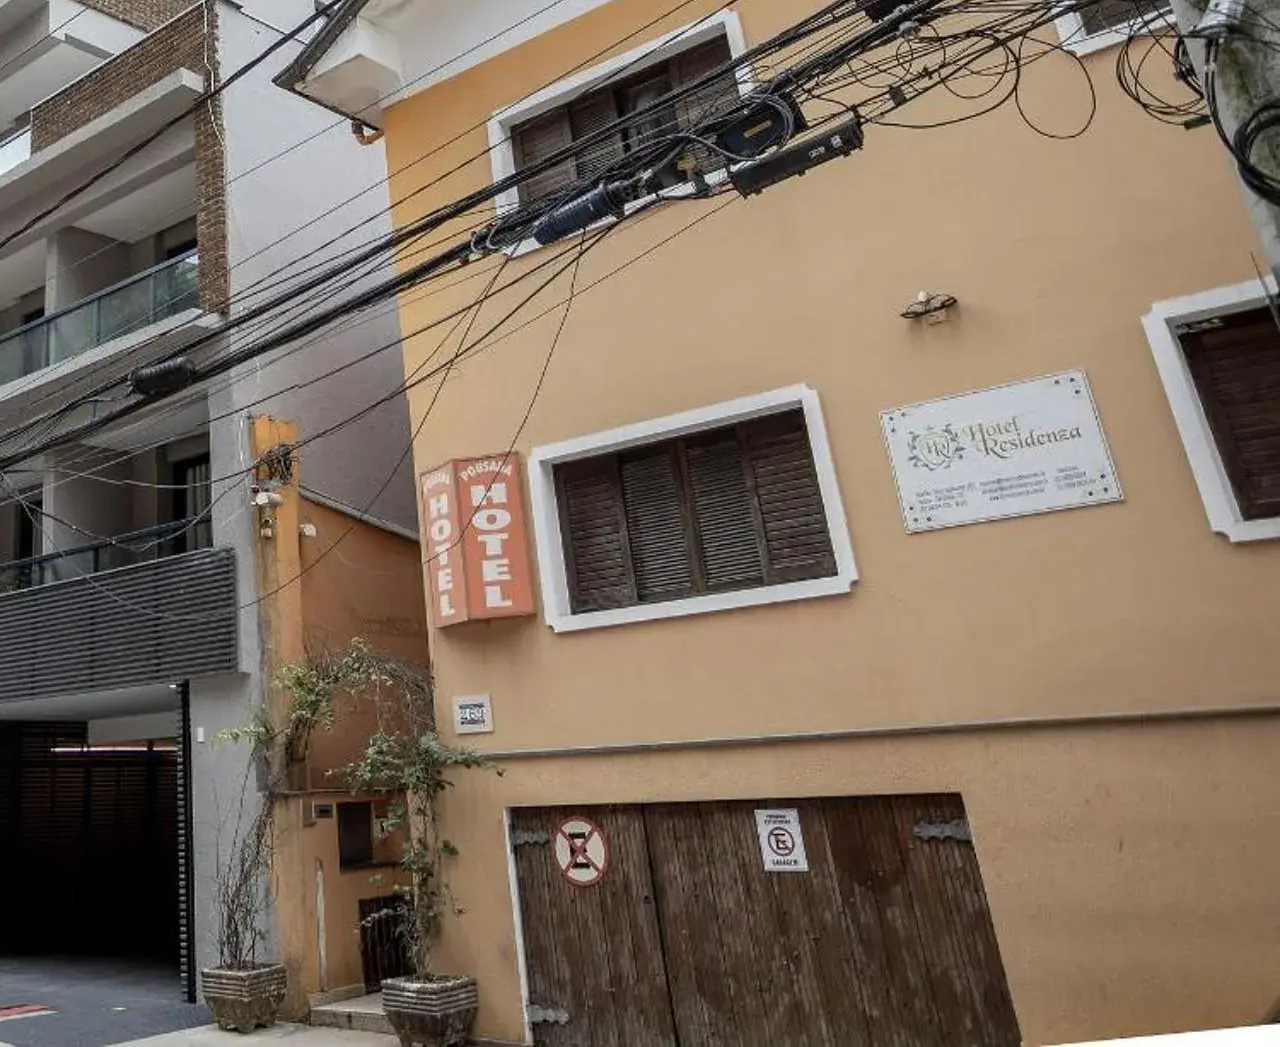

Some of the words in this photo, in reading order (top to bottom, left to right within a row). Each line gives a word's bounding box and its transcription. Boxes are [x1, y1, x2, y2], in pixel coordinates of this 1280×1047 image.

[962, 415, 1019, 443] Hotel
[983, 424, 1082, 459] Residenza
[459, 460, 513, 482] POUSADA
[429, 493, 455, 617] HOTEL
[471, 483, 513, 608] HOTEL
